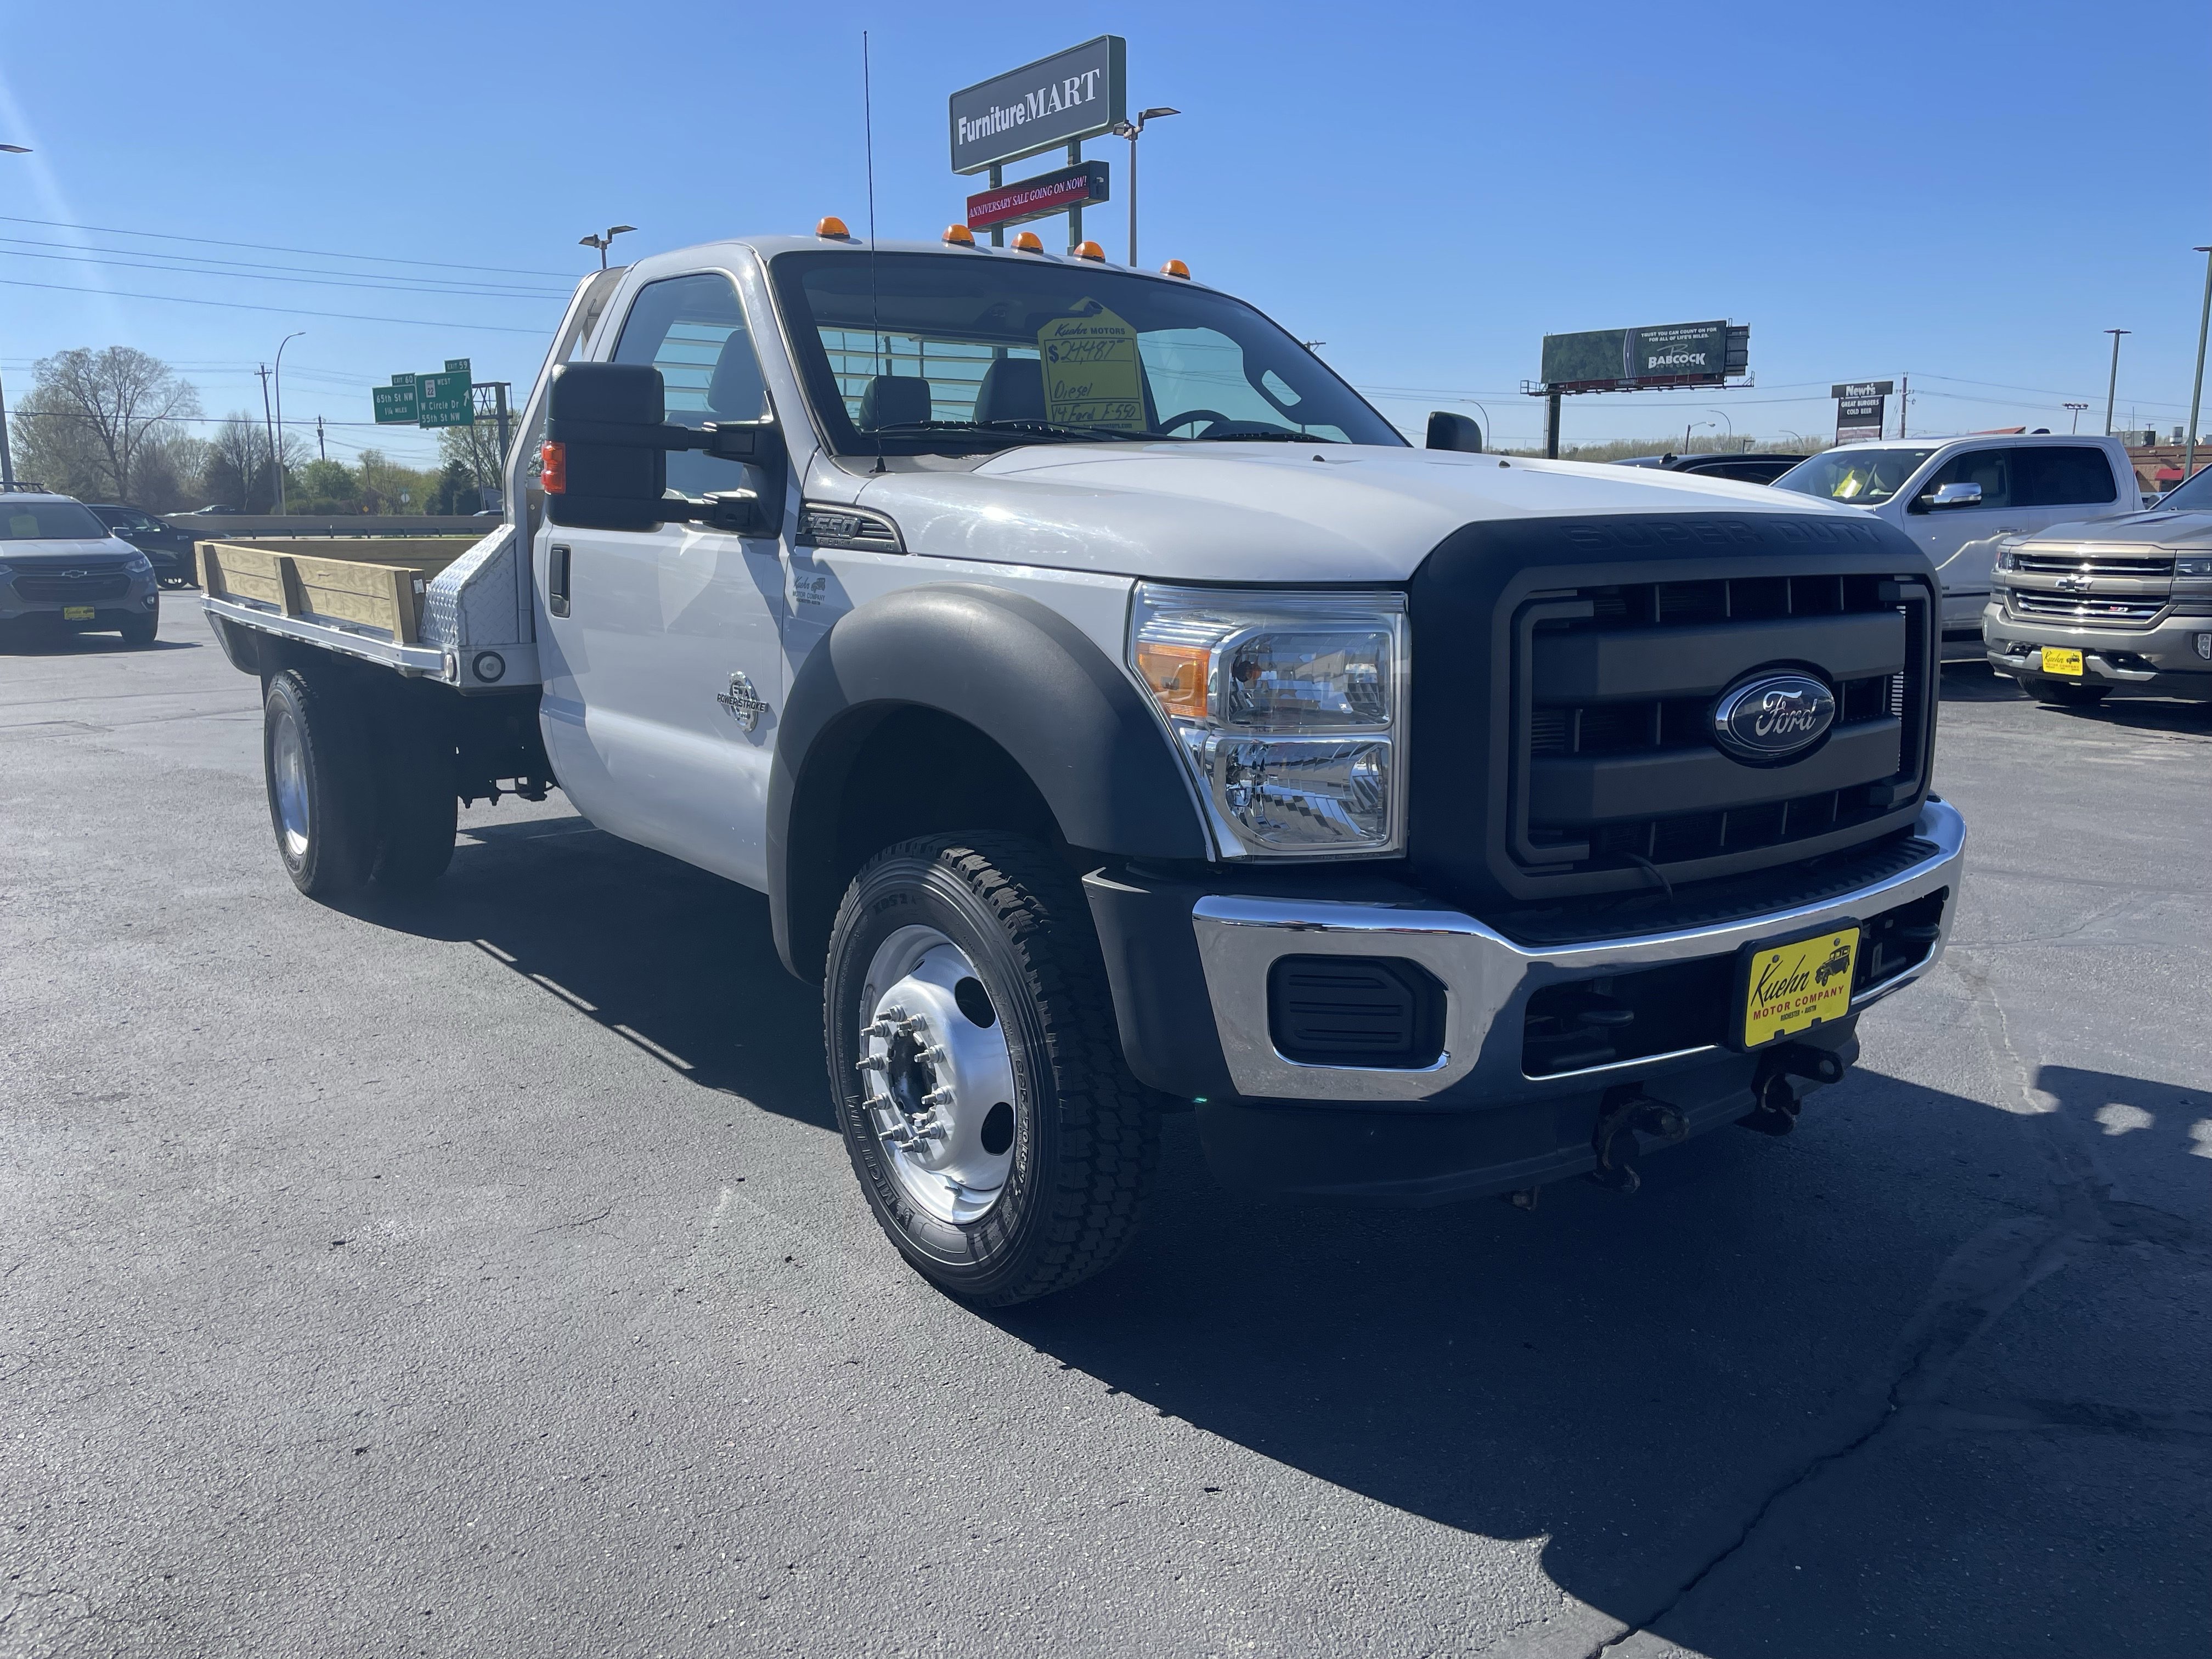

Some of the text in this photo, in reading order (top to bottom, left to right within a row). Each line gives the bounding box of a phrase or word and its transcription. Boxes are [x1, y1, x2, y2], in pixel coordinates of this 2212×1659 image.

[958, 68, 1100, 145] FurnitureMART
[969, 175, 1087, 218] ANNIVERSARY SALE GOING ON NOW!
[459, 360, 467, 370] 59
[1648, 352, 1706, 369] BABCOCK
[405, 375, 413, 383] 60
[427, 387, 434, 396] 22
[1054, 380, 1093, 399] Diesel
[1846, 383, 1876, 397] Newt's
[376, 392, 413, 404] 65th St NW
[421, 399, 459, 411] W Circle Dr
[1841, 400, 1856, 408] GREAT
[421, 412, 460, 424] 55th St NW
[1069, 404, 1096, 421] Ford
[1559, 520, 1881, 551] SUPER DUTY
[793, 575, 810, 590] Kuehn
[806, 592, 826, 601] COMPANY
[2044, 650, 2064, 663] Kuehn
[1756, 690, 1818, 737] Ford
[1751, 954, 1810, 1008] Kuehn
[1753, 985, 1844, 1020] MOTOR COMPANY
